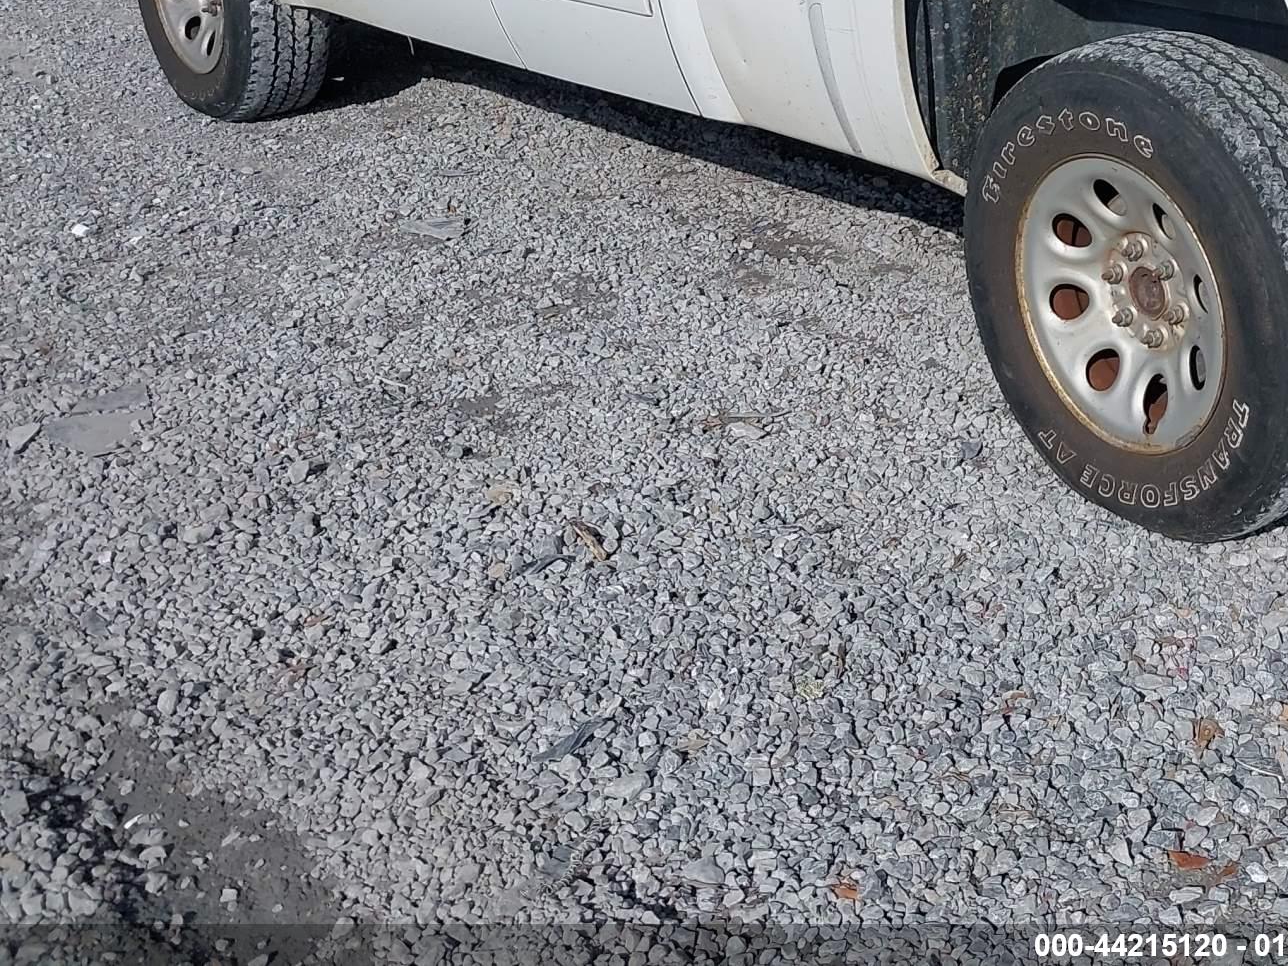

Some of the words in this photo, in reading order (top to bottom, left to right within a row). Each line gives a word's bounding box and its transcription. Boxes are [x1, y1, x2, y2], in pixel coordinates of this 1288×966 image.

[981, 107, 1154, 204] Firestone
[1038, 427, 1077, 464] AT
[1079, 398, 1251, 509] TRANSFORCE
